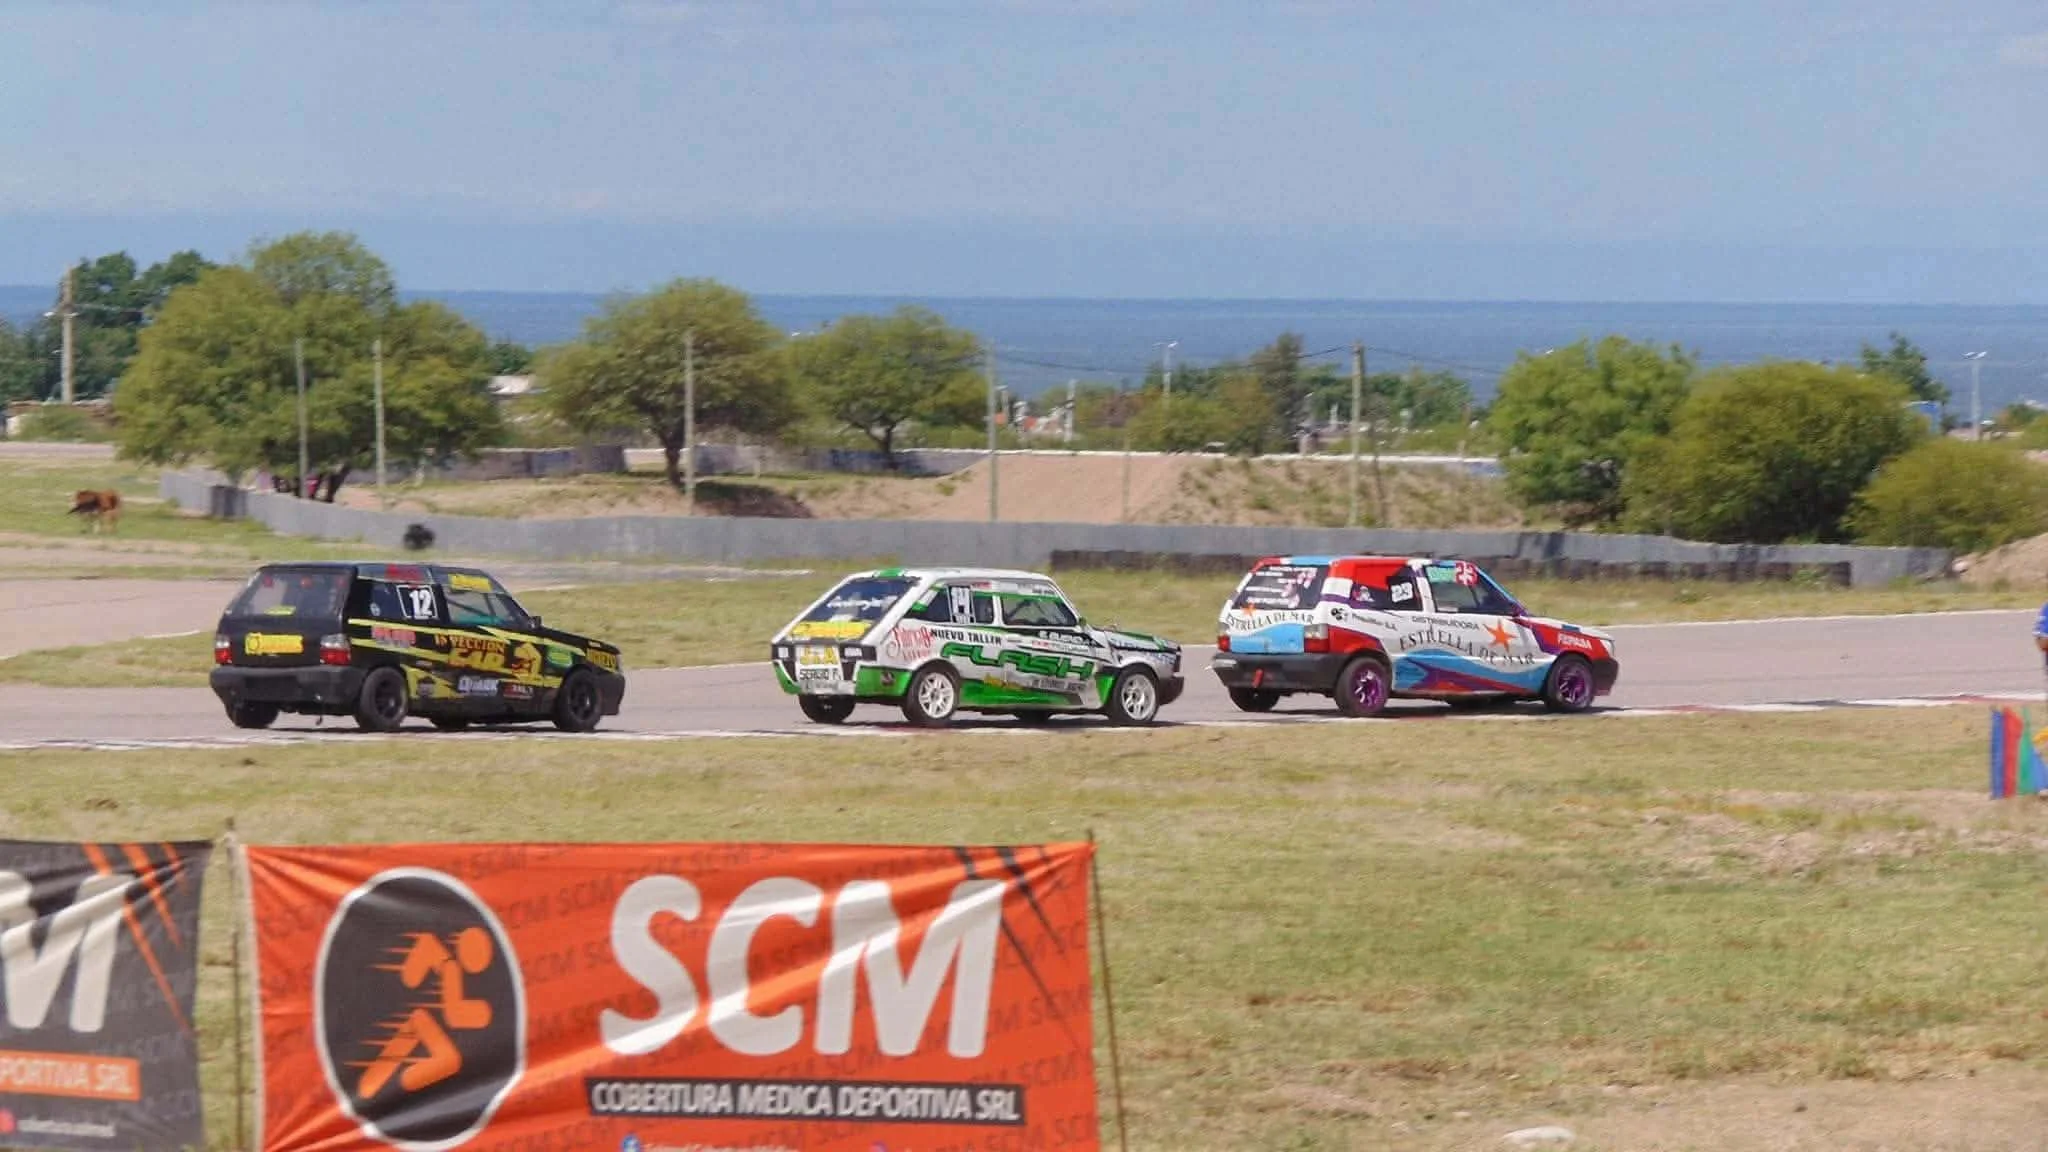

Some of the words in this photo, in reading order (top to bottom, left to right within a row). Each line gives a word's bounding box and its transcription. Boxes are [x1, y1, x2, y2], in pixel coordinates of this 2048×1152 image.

[409, 589, 433, 620] 12
[1289, 611, 1315, 625] MAR
[930, 628, 965, 642] NUEVO
[967, 631, 1002, 646] TALLER
[1399, 627, 1475, 657] ESTRELLA
[1478, 646, 1497, 665] DE
[1503, 652, 1536, 666] MAR
[940, 641, 1095, 681] FLASH
[600, 873, 1008, 1060] SCM
[592, 1082, 735, 1114] COBERTURA
[734, 1083, 833, 1117] MEDICA
[836, 1086, 973, 1120] DEPORTIVA
[975, 1088, 1021, 1122] SRL
